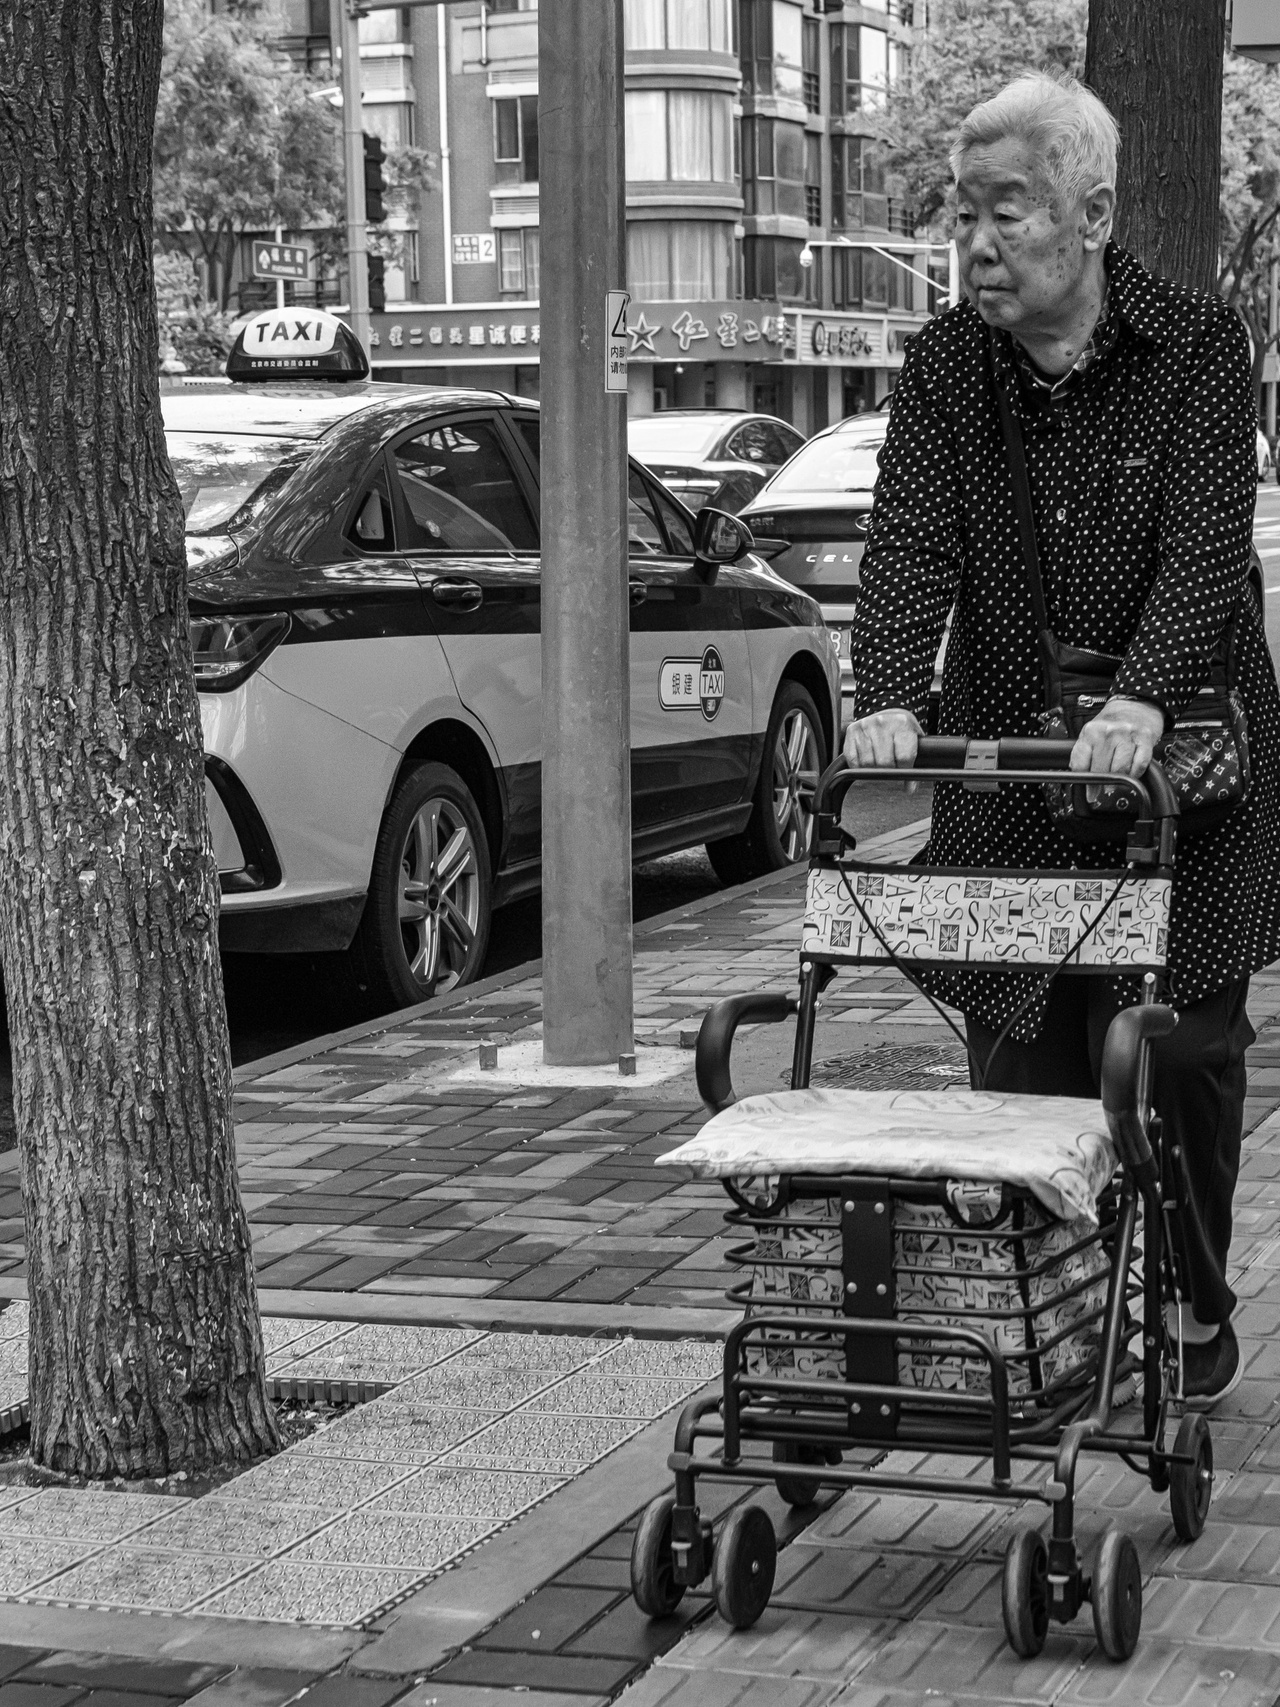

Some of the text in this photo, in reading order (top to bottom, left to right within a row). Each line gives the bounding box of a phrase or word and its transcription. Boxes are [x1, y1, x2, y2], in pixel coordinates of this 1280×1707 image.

[483, 239, 493, 257] 2
[256, 321, 323, 343] TAXI
[702, 673, 723, 695] TAXI
